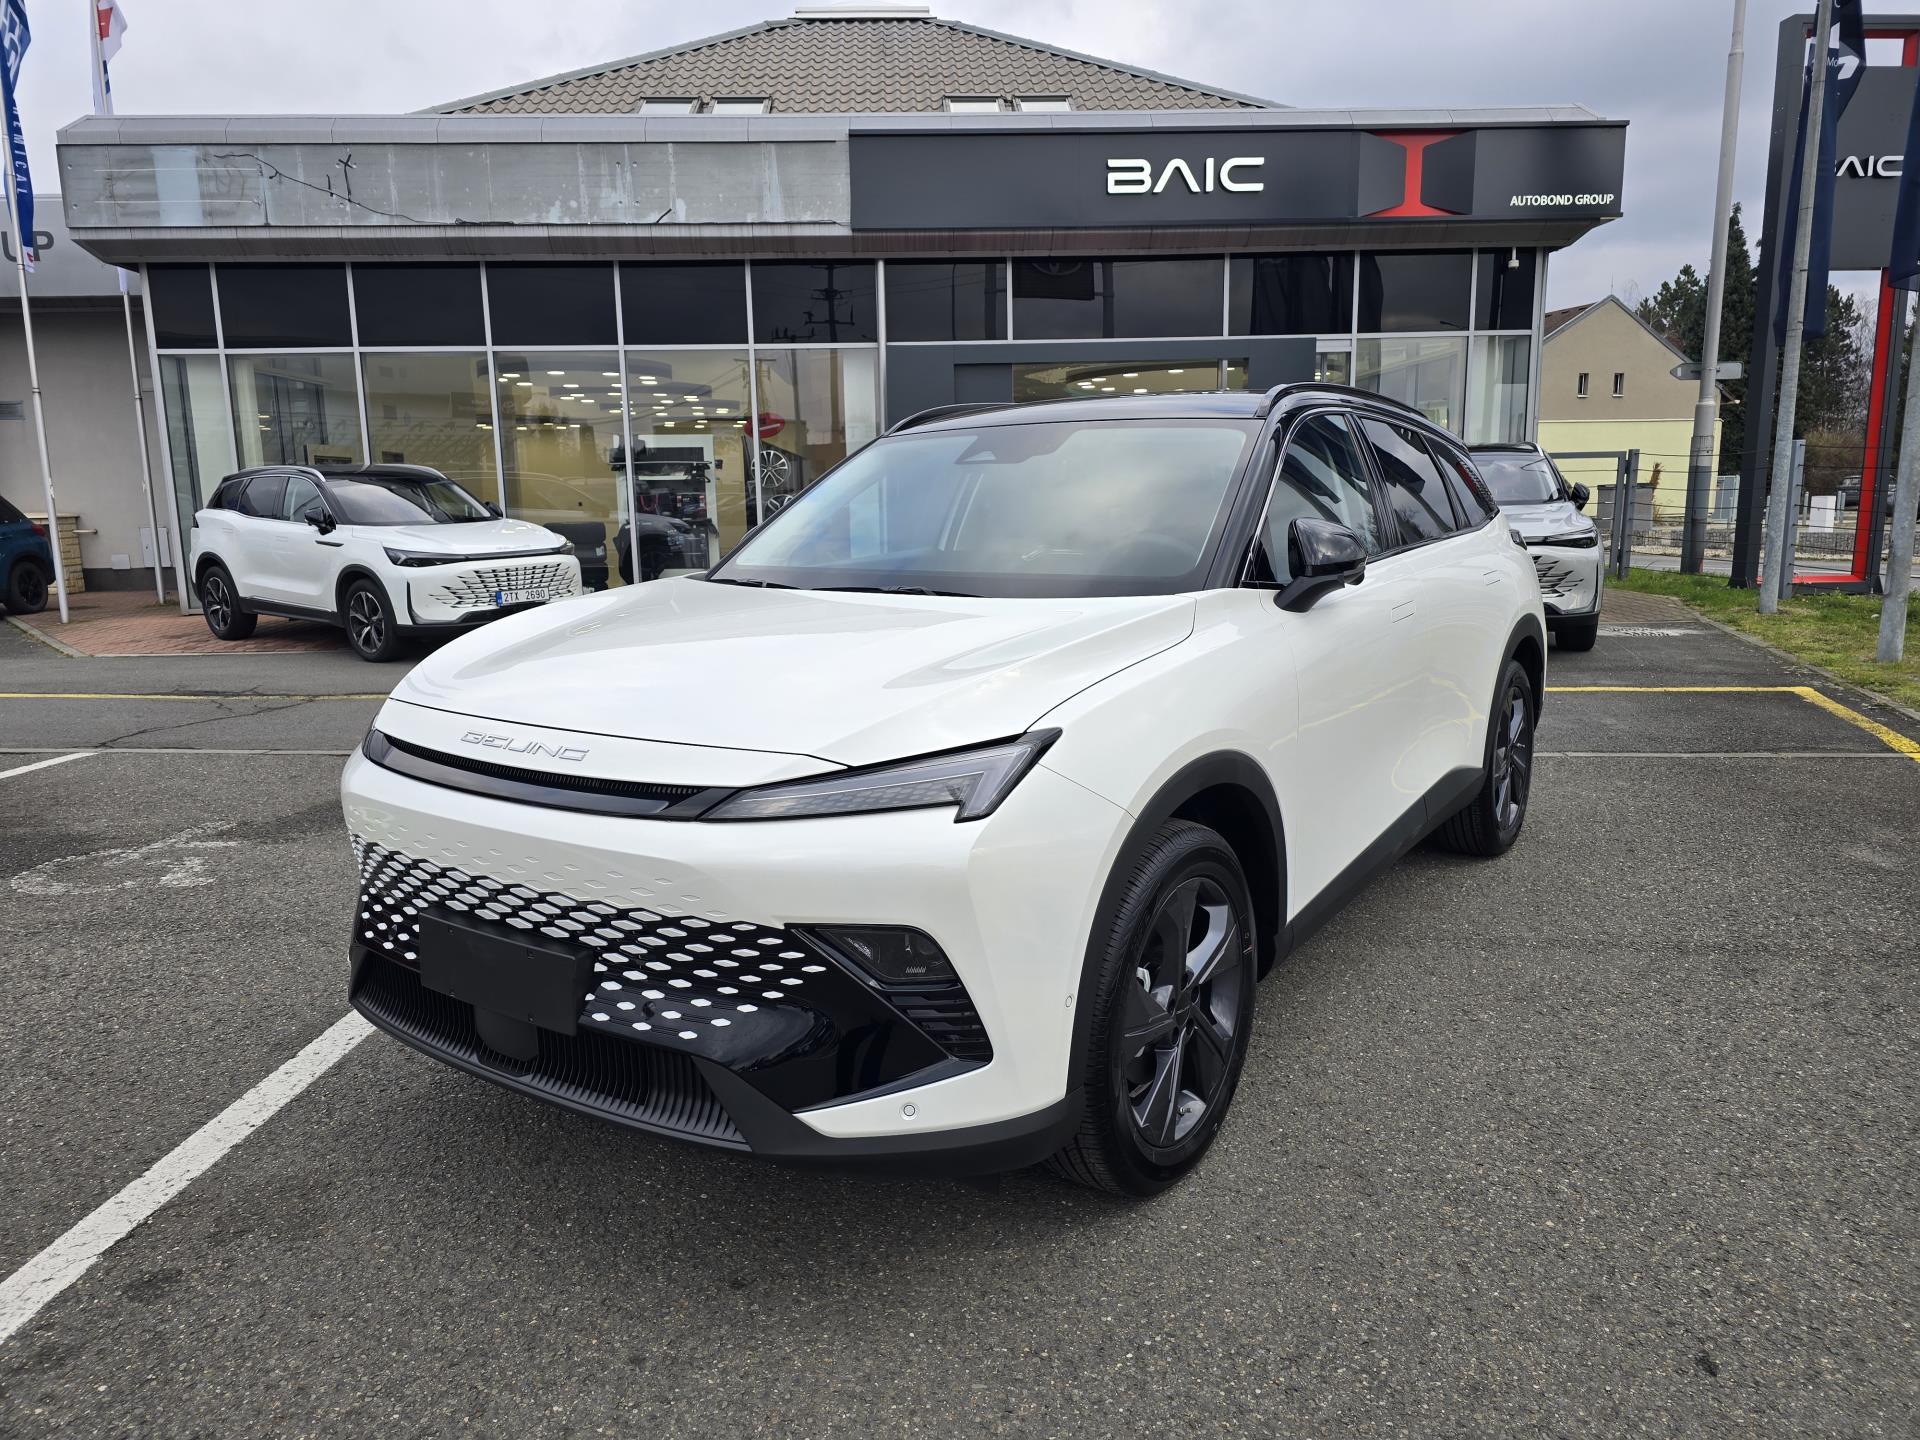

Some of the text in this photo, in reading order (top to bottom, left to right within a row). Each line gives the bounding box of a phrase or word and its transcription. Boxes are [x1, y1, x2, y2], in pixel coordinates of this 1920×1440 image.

[1107, 156, 1265, 194] BAIC
[1834, 155, 1905, 177] AIC
[1509, 193, 1615, 207] AUTOBOND GROUP
[503, 588, 546, 603] 2TX 2690
[460, 730, 591, 762] BEIJING
